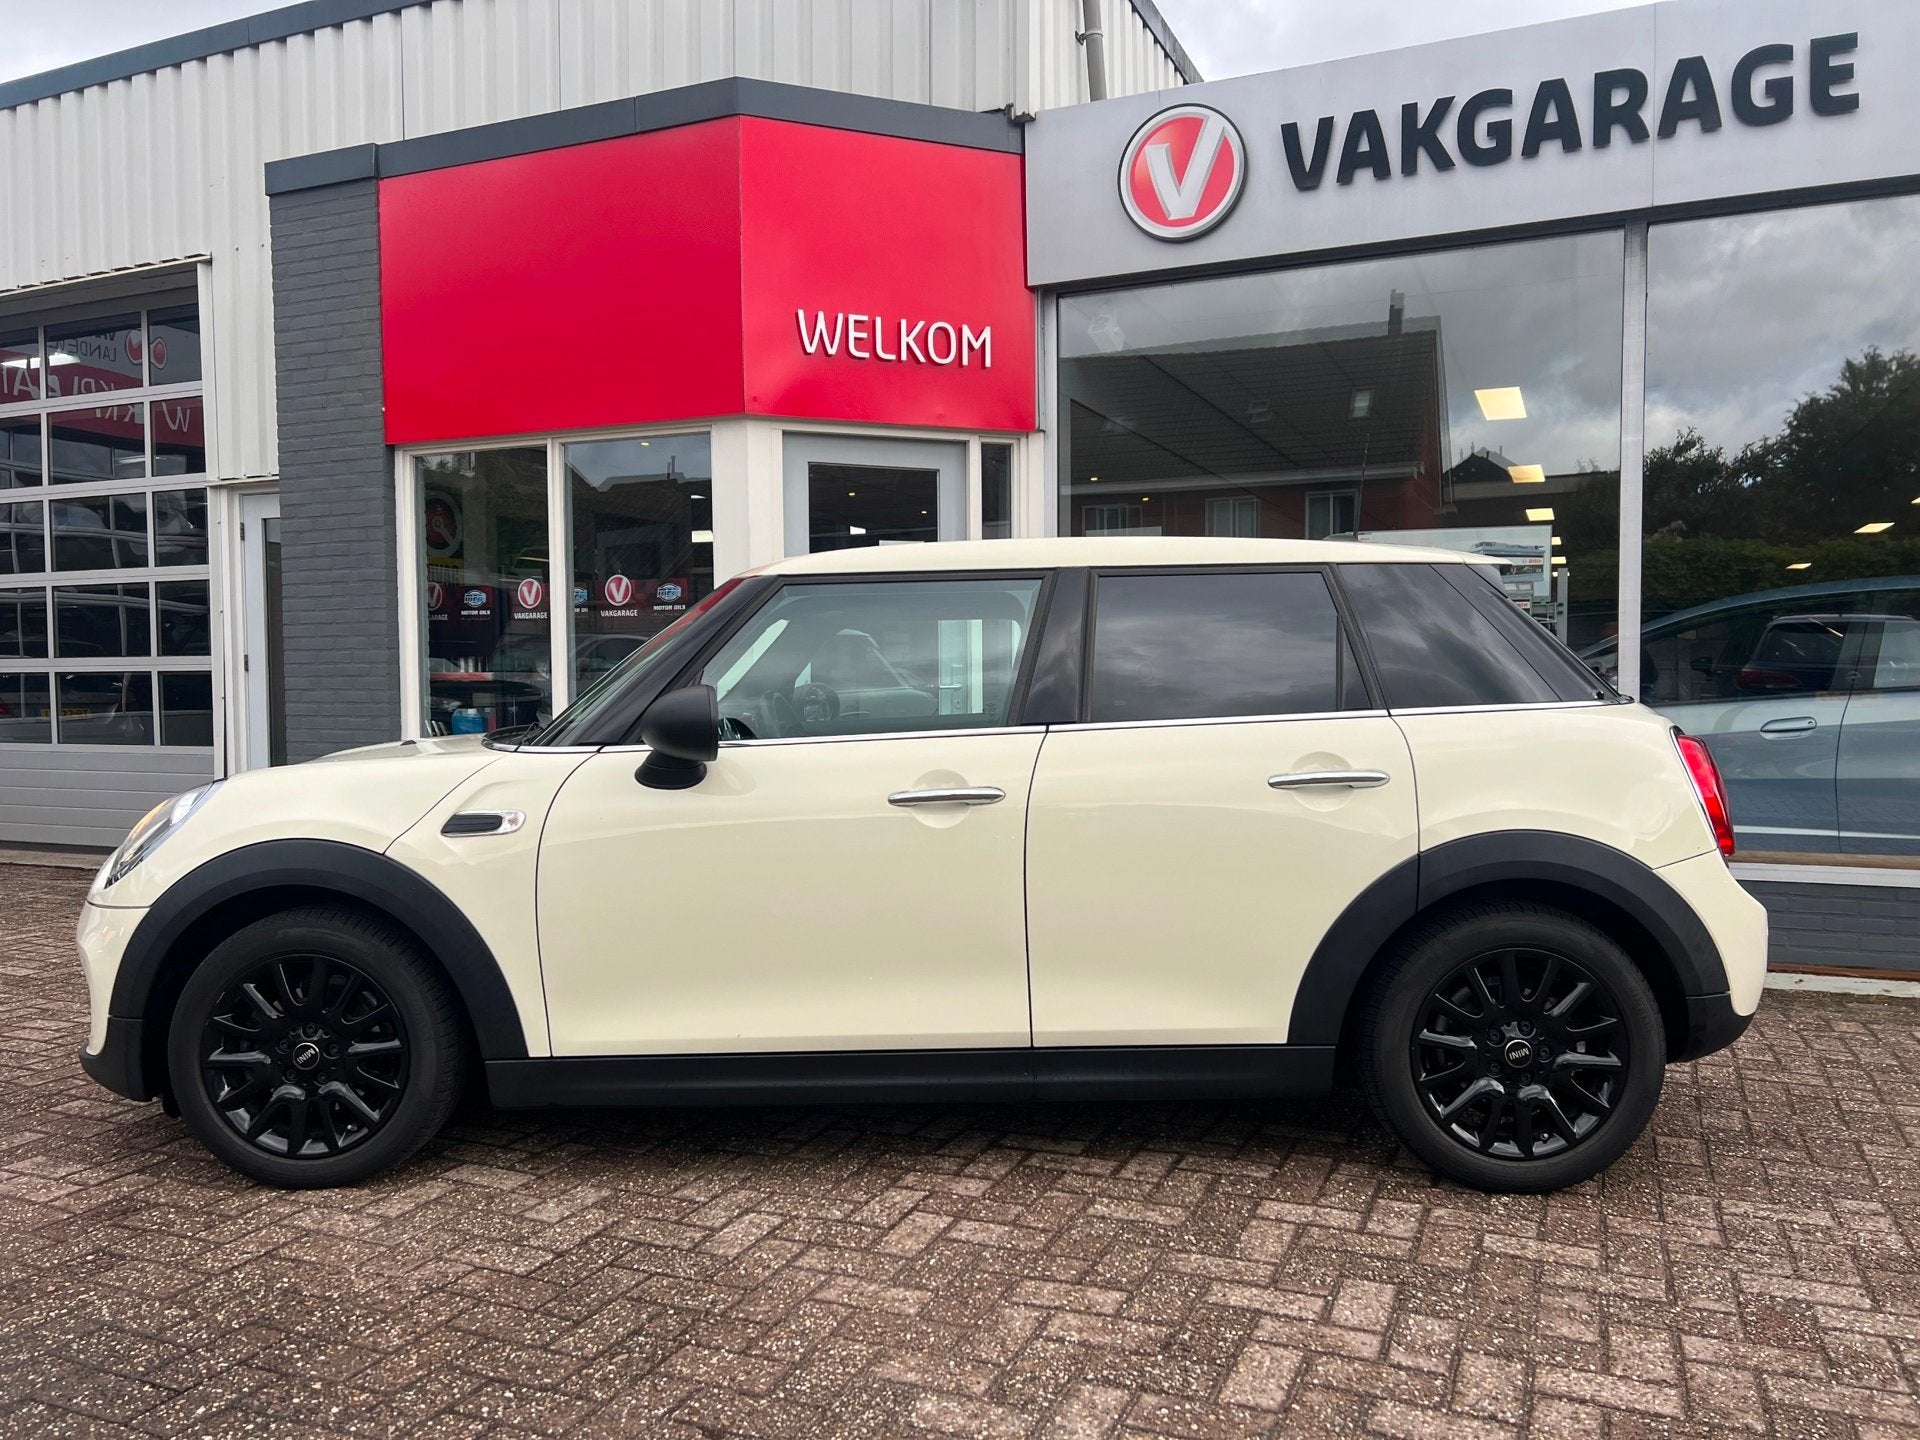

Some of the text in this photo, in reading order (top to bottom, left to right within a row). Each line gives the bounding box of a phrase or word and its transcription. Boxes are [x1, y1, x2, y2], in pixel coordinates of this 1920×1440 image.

[1281, 32, 1859, 191] VAKGARAGE
[797, 309, 991, 368] WELKOM
[600, 609, 638, 617] VAKGARAGE
[296, 1048, 316, 1064] MINI
[1509, 1047, 1529, 1060] MINI
